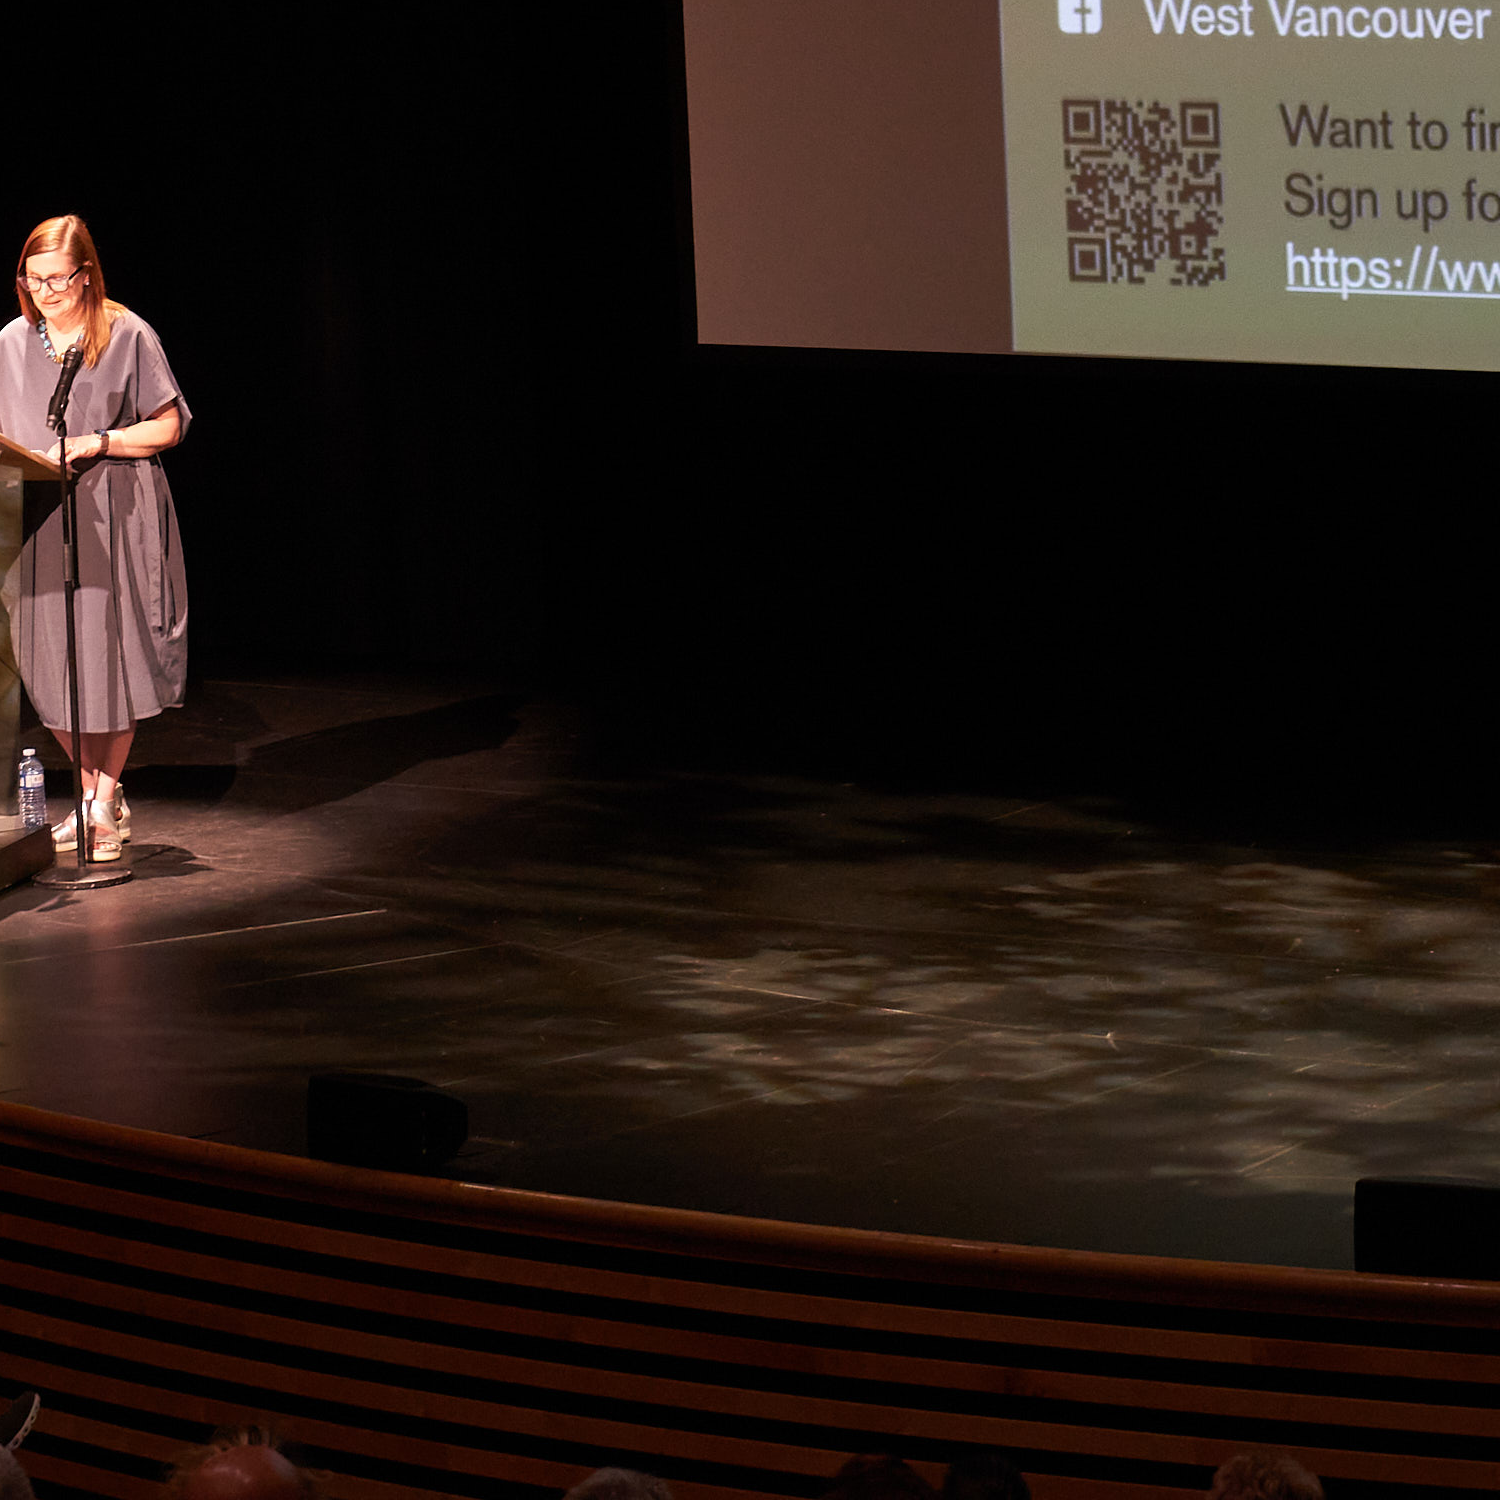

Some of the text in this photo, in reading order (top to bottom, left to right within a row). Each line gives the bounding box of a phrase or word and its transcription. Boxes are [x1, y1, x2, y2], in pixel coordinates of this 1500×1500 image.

[1280, 103, 1393, 151] Want
[1407, 110, 1449, 152] to
[1284, 173, 1379, 231] Sign
[1394, 187, 1449, 233] up
